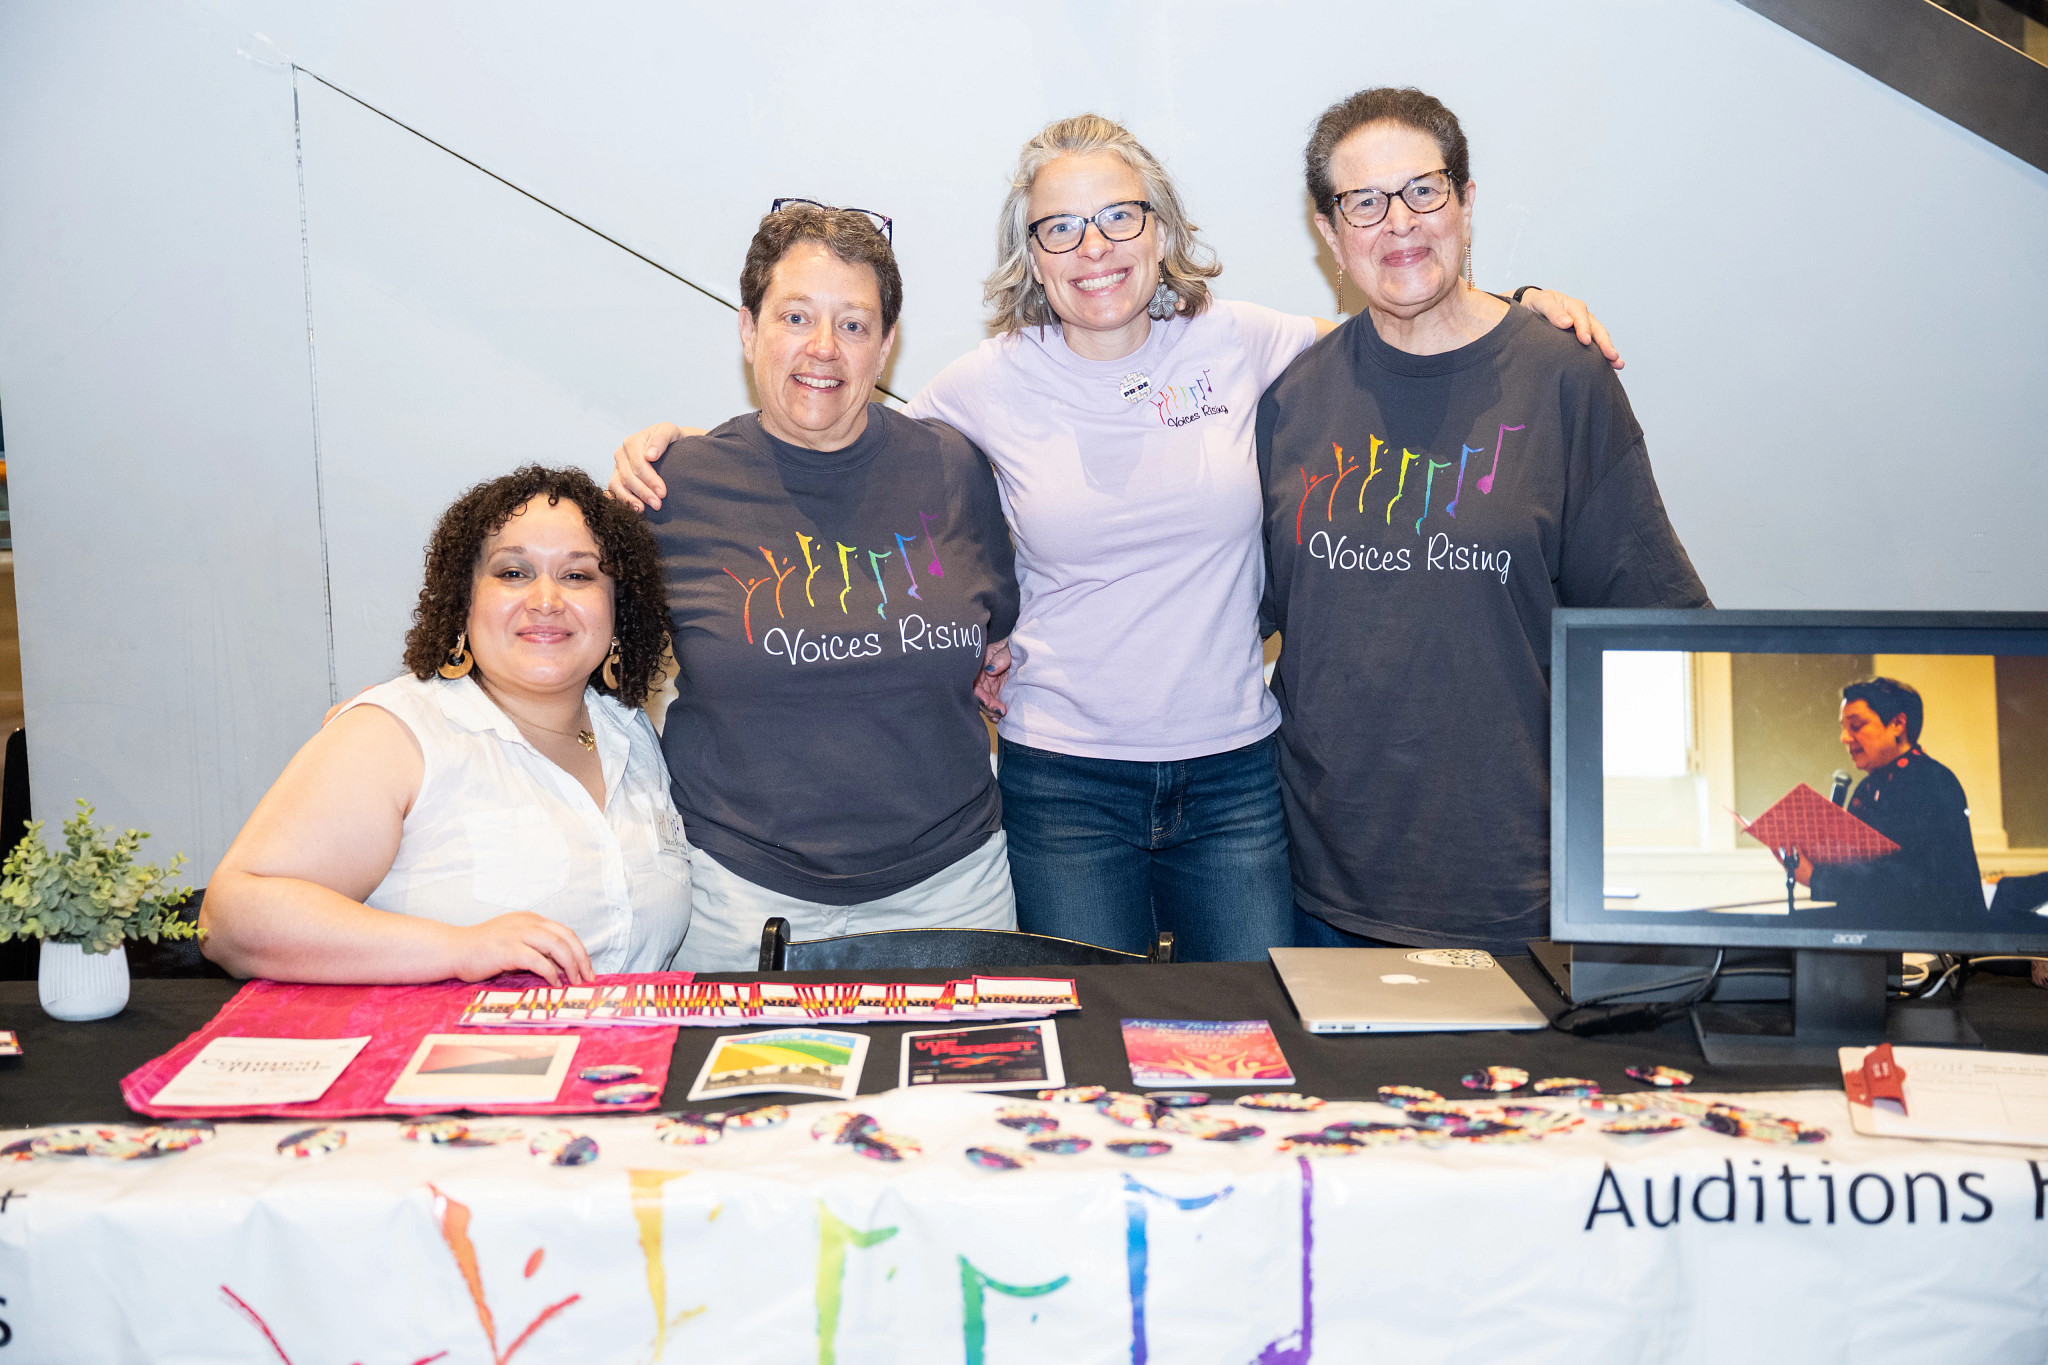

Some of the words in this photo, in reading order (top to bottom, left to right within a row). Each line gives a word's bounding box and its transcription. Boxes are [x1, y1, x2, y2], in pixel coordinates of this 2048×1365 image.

[1123, 381, 1149, 397] PRIDE
[1167, 412, 1200, 428] Voices
[1201, 404, 1229, 417] Rising
[1309, 530, 1411, 571] Voices
[1427, 532, 1512, 585] Rising
[763, 627, 882, 666] Voices
[898, 613, 982, 658] Rising
[1832, 933, 1868, 945] acer
[1584, 1157, 1994, 1232] Auditions
